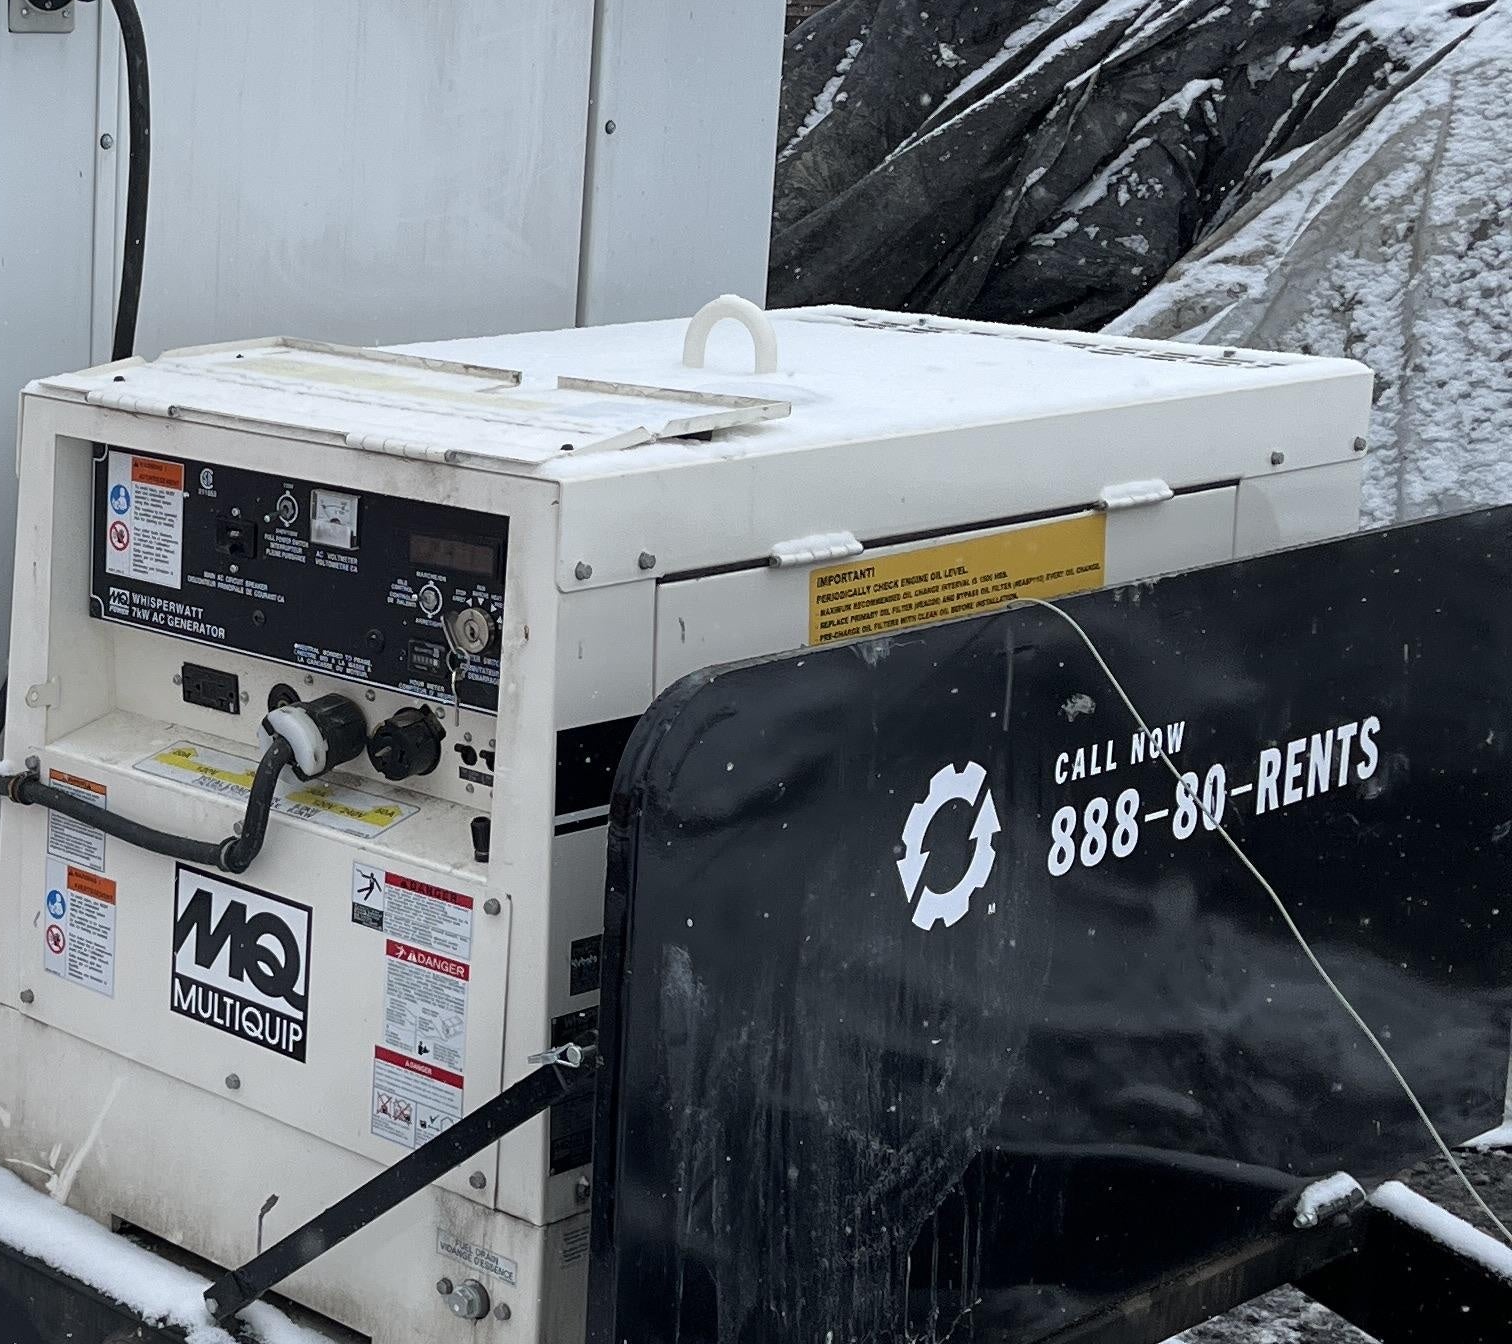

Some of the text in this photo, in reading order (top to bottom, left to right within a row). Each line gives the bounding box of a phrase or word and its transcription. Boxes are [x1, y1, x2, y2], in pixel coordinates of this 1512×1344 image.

[816, 566, 875, 588] IMPORTANT!
[873, 579, 899, 593] CHECK
[930, 570, 943, 581] OIL
[131, 592, 204, 620] WHISPERWATT
[131, 606, 226, 640] 7kW AC GENERATOR
[1055, 720, 1186, 785] CALL NOW
[1047, 715, 1381, 877] 888-80-RENTS
[407, 880, 458, 903] DANGER
[174, 888, 304, 1013] MQ
[417, 953, 465, 978] DANGER
[174, 977, 303, 1053] MULTIQUIP
